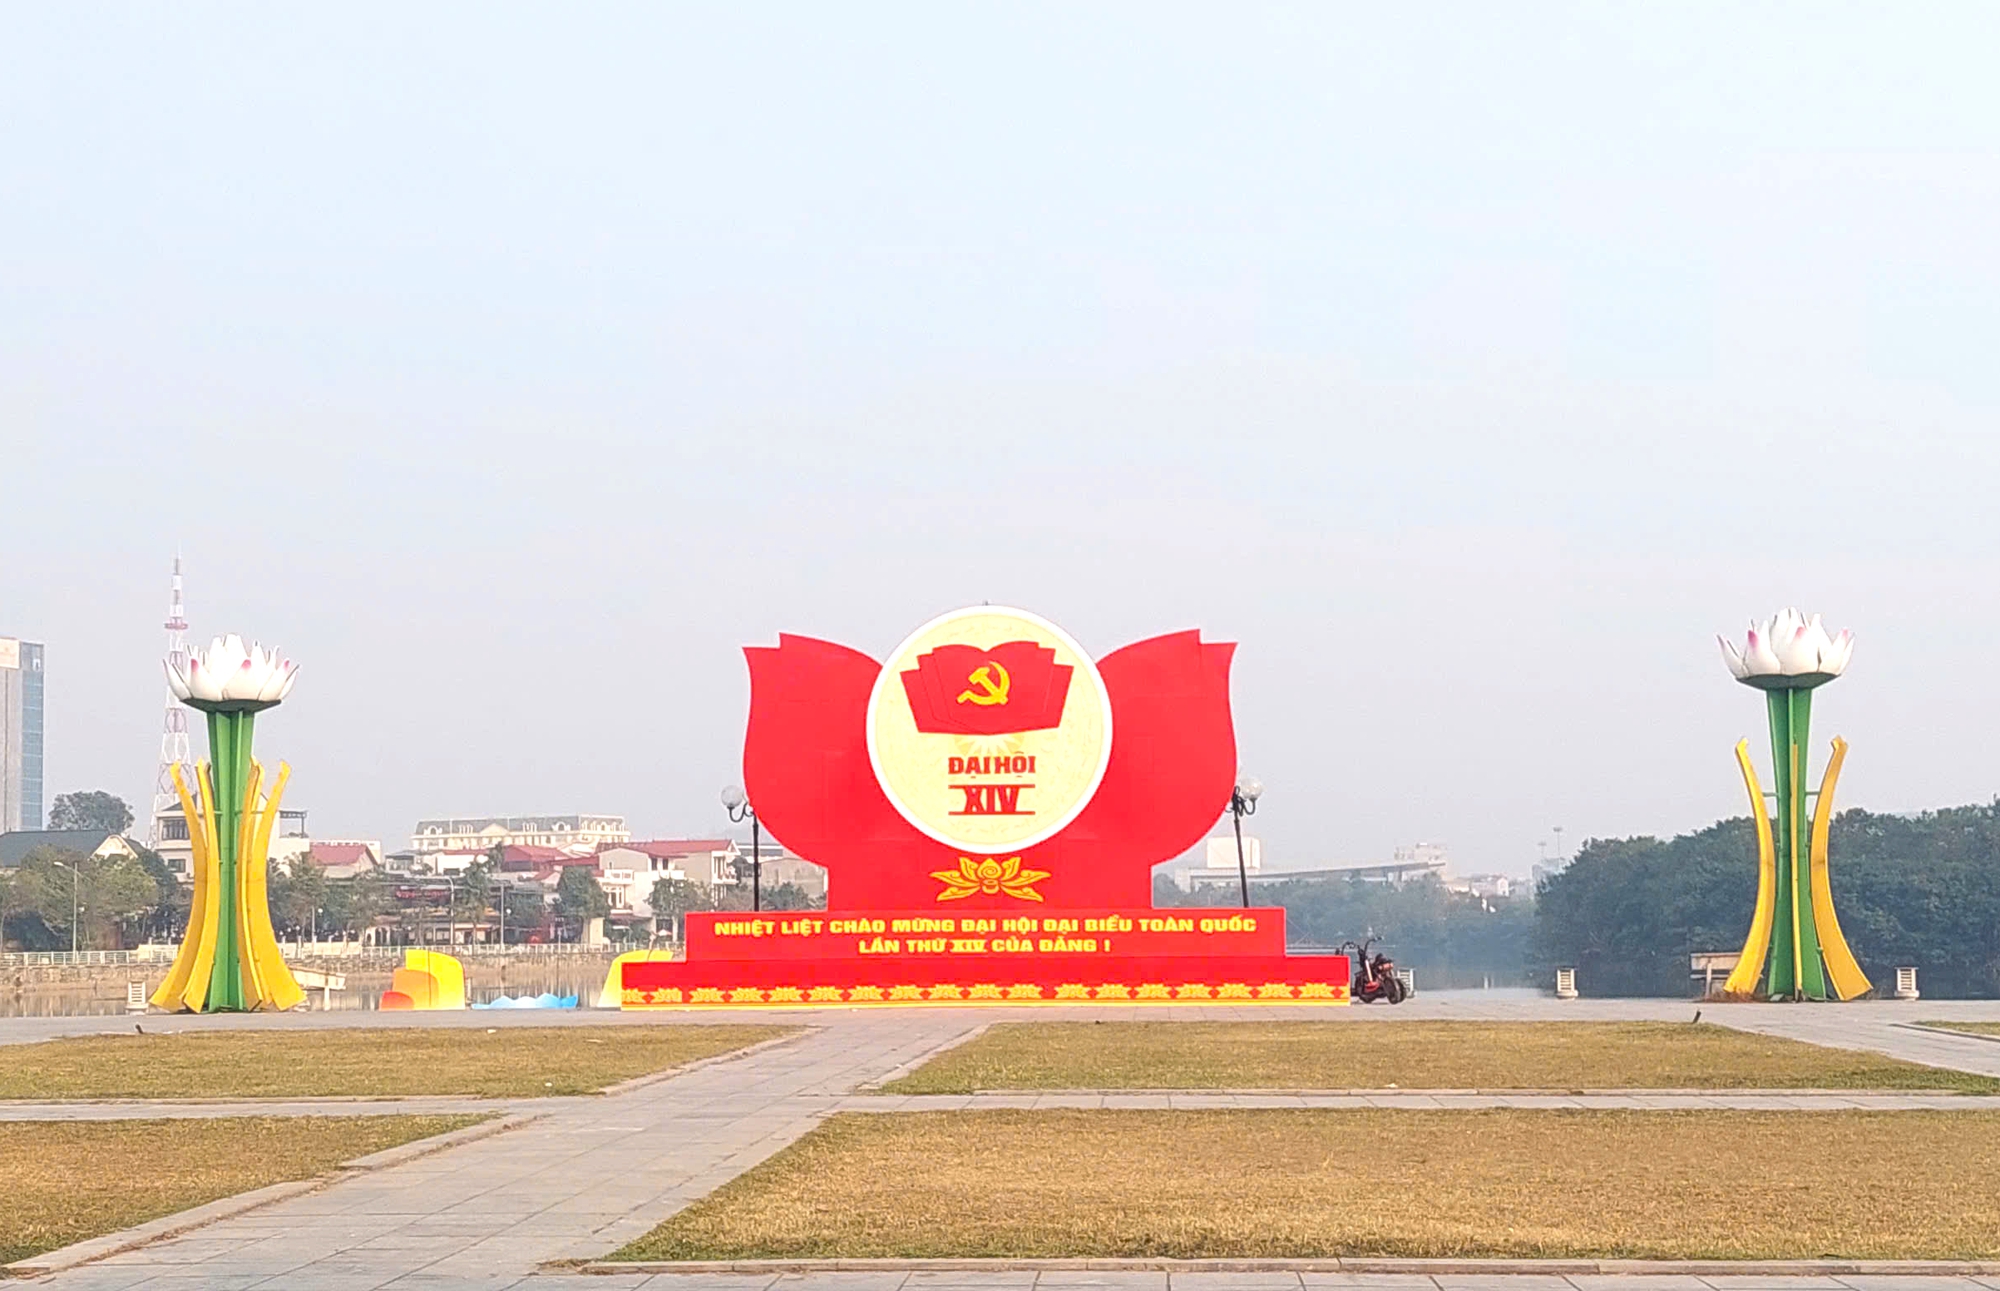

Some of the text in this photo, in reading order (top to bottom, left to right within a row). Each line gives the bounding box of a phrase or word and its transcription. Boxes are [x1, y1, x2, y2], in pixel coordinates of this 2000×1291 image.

[948, 751, 1036, 779] ĐẠI HỘI
[962, 784, 1020, 815] XIV
[713, 919, 775, 937] NHIỆT
[780, 918, 824, 936] LIỆT
[829, 917, 886, 934] CHÀO
[960, 918, 997, 935] ĐẠI
[1002, 916, 1038, 935] HỘI
[1042, 918, 1078, 936] ĐẠI
[1138, 916, 1194, 933] TOÀN
[1199, 914, 1257, 934] QUỐC
[948, 938, 988, 953] XIV
[1103, 939, 1111, 953] !
